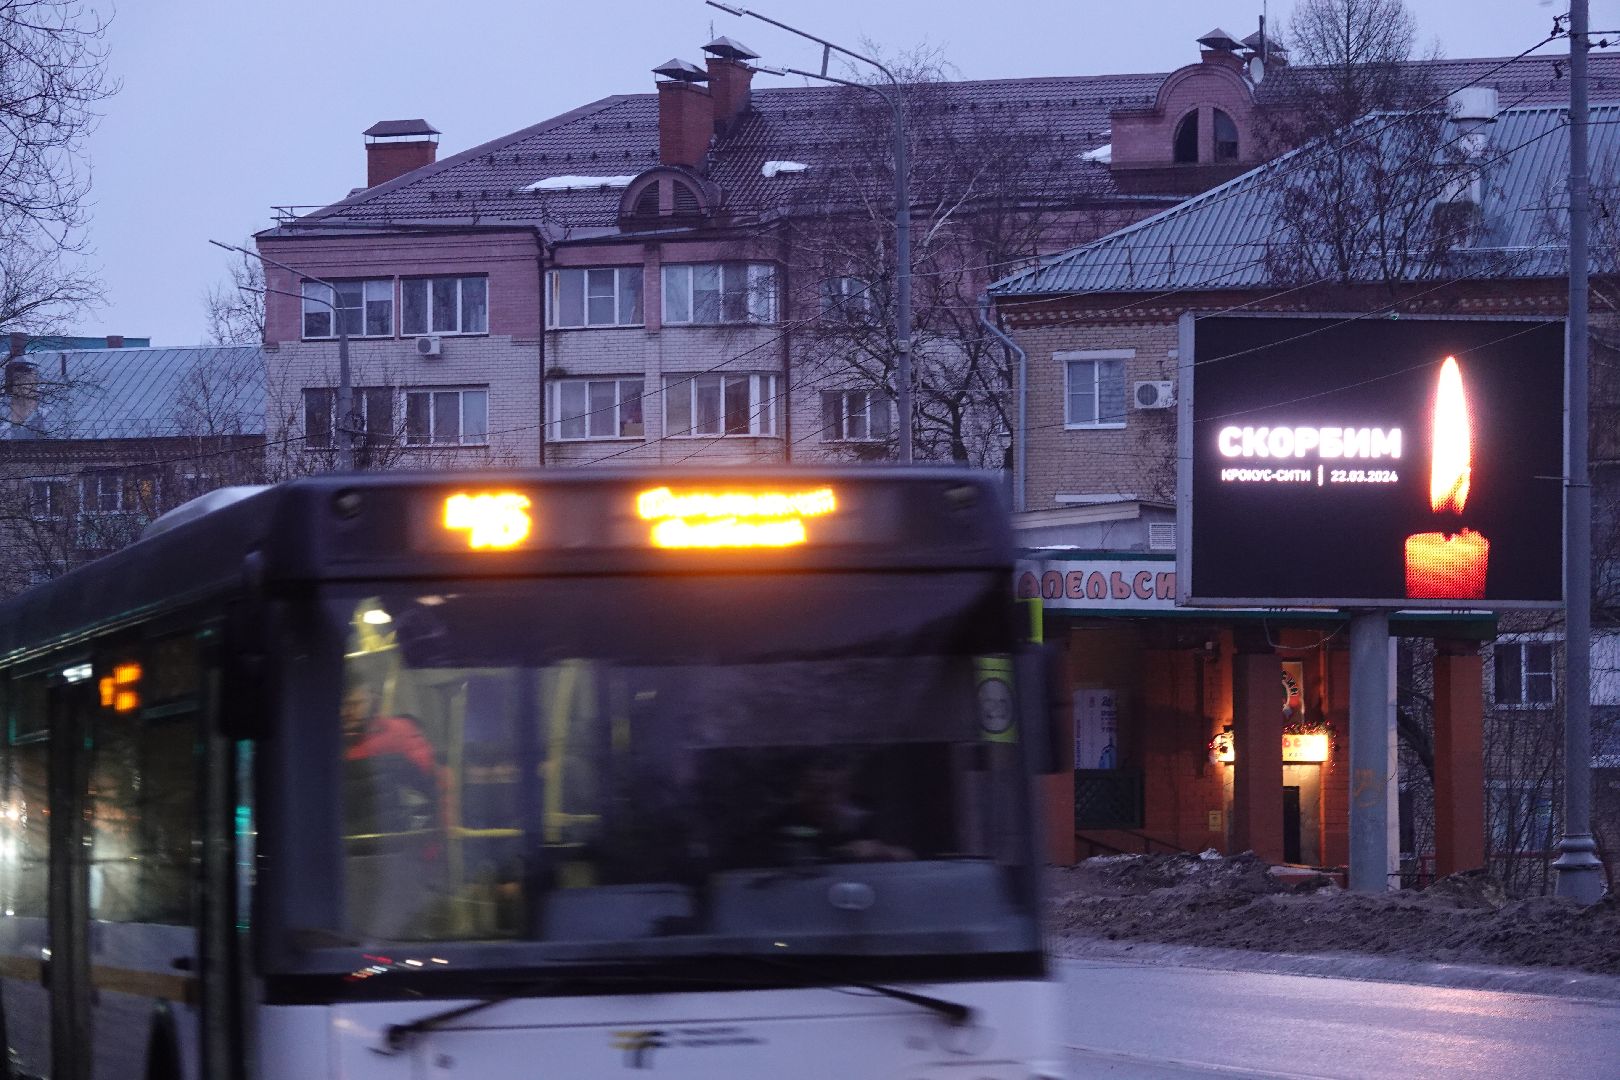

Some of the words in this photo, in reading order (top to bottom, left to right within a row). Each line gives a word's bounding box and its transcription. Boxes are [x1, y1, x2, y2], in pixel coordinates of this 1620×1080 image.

[1218, 426, 1402, 458] СКОРБИМ
[1221, 469, 1311, 481] КРОКУС-СИТИ
[1330, 470, 1399, 483] 22.03.2024
